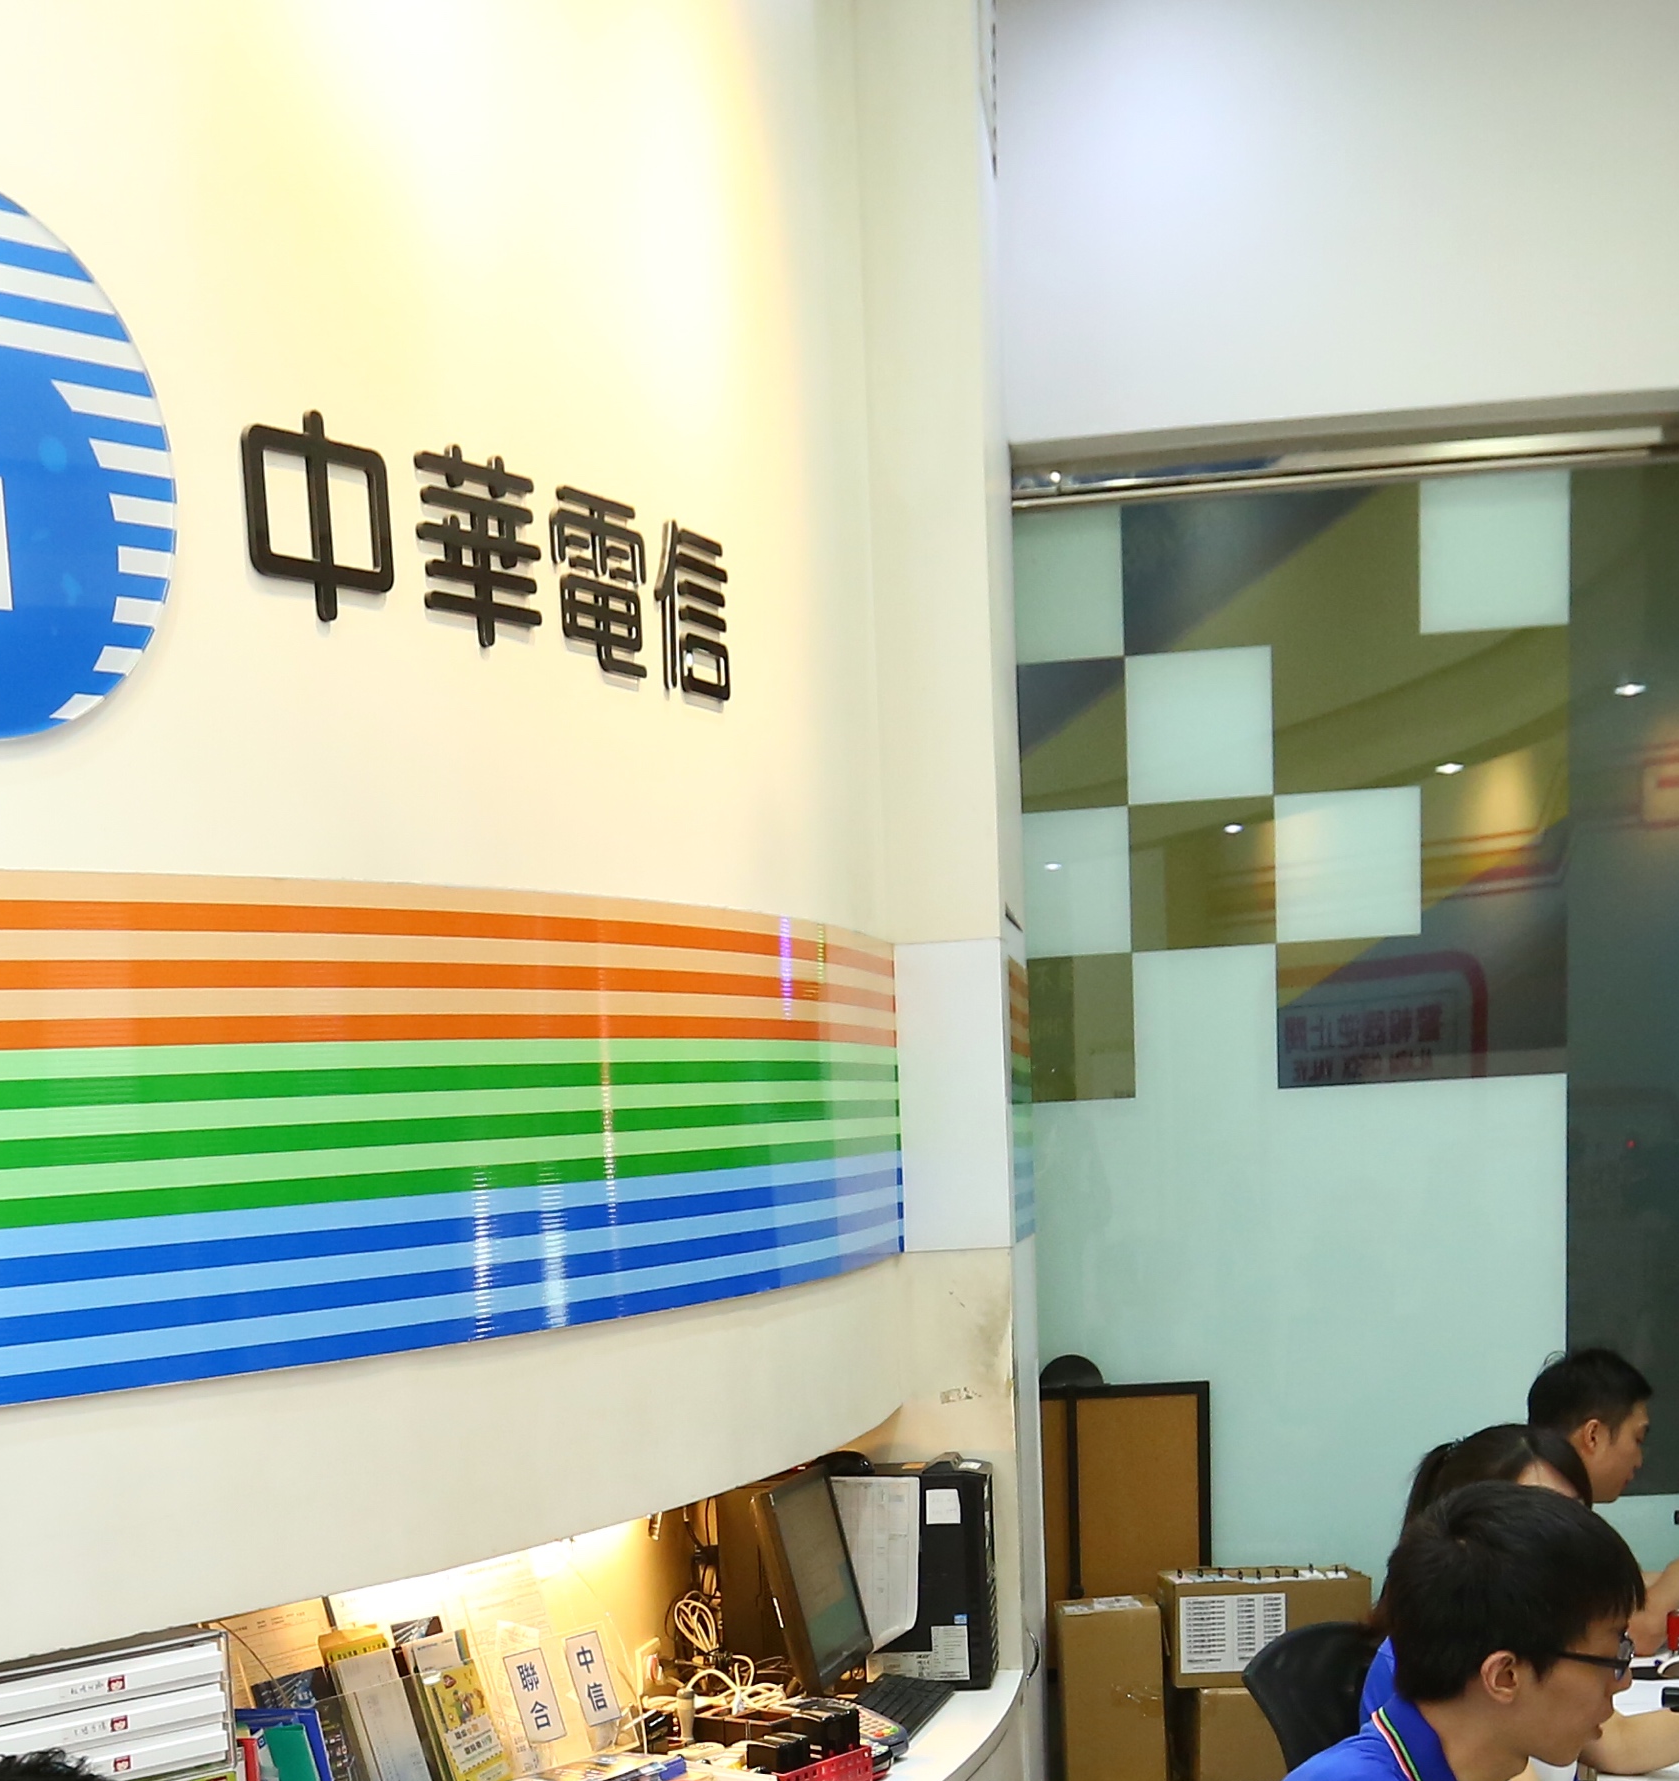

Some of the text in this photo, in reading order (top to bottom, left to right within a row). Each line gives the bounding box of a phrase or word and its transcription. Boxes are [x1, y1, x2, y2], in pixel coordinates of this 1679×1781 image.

[238, 409, 732, 702] 中華電信
[516, 1662, 551, 1730] 聯合
[576, 1646, 608, 1712] 中信
